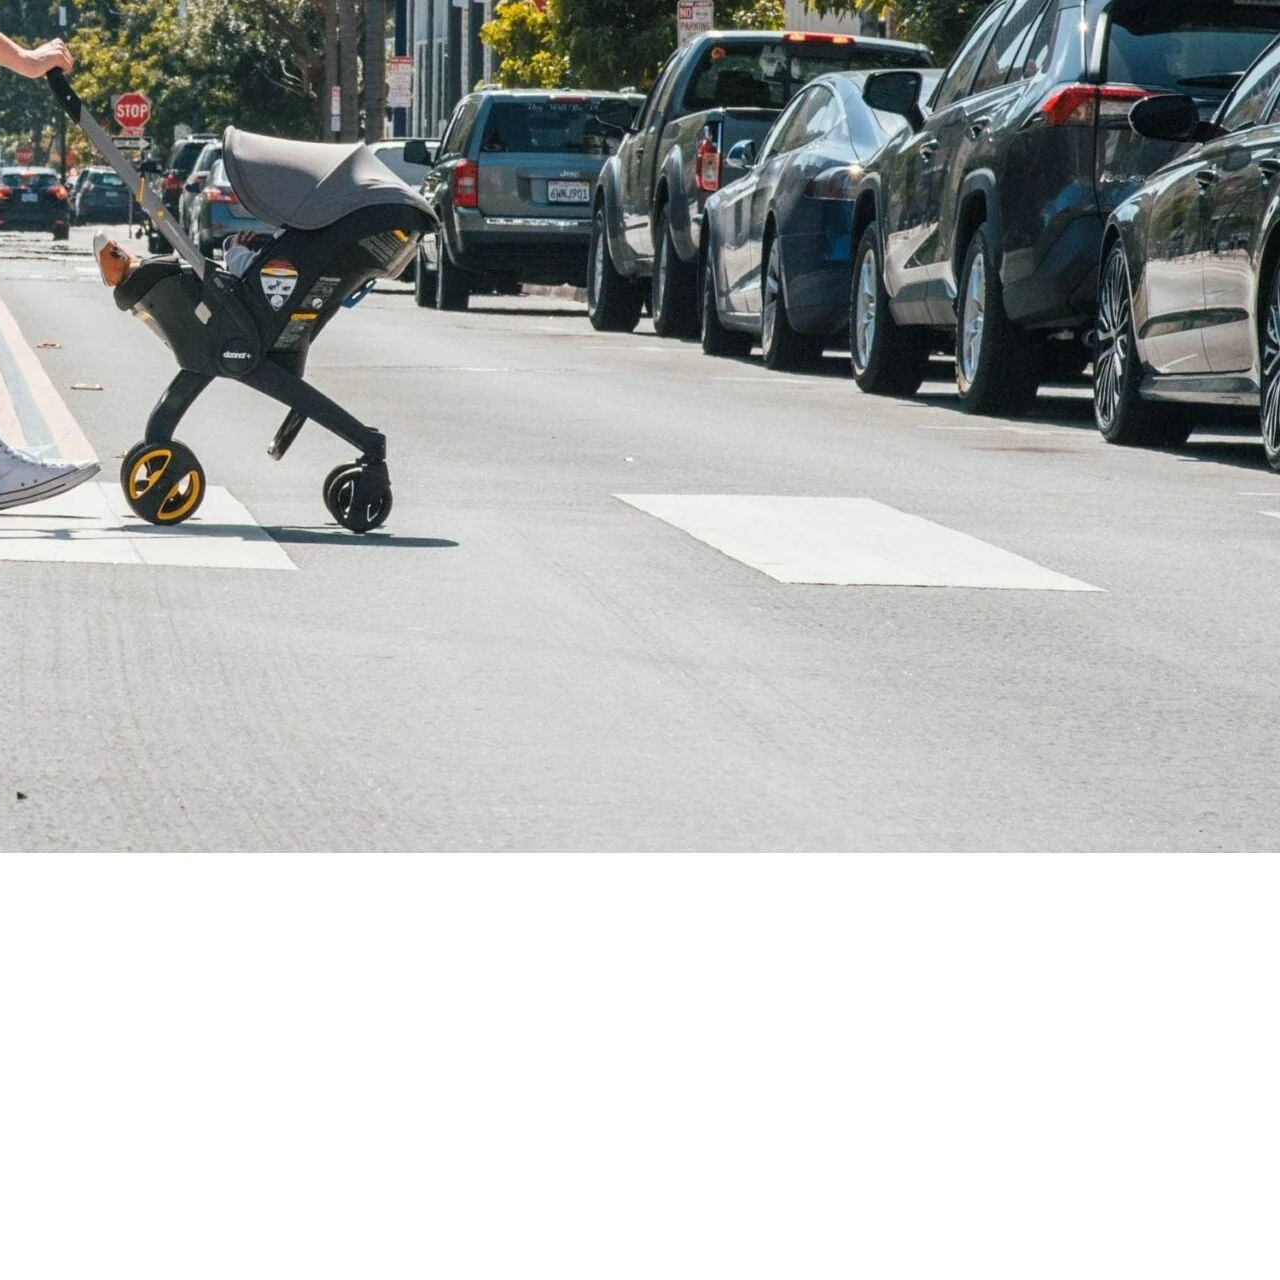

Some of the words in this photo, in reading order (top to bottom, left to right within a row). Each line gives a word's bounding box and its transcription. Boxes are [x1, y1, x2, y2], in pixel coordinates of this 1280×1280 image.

[680, 7, 691, 18] NO
[116, 104, 148, 118] STOP
[560, 170, 580, 178] Jeep
